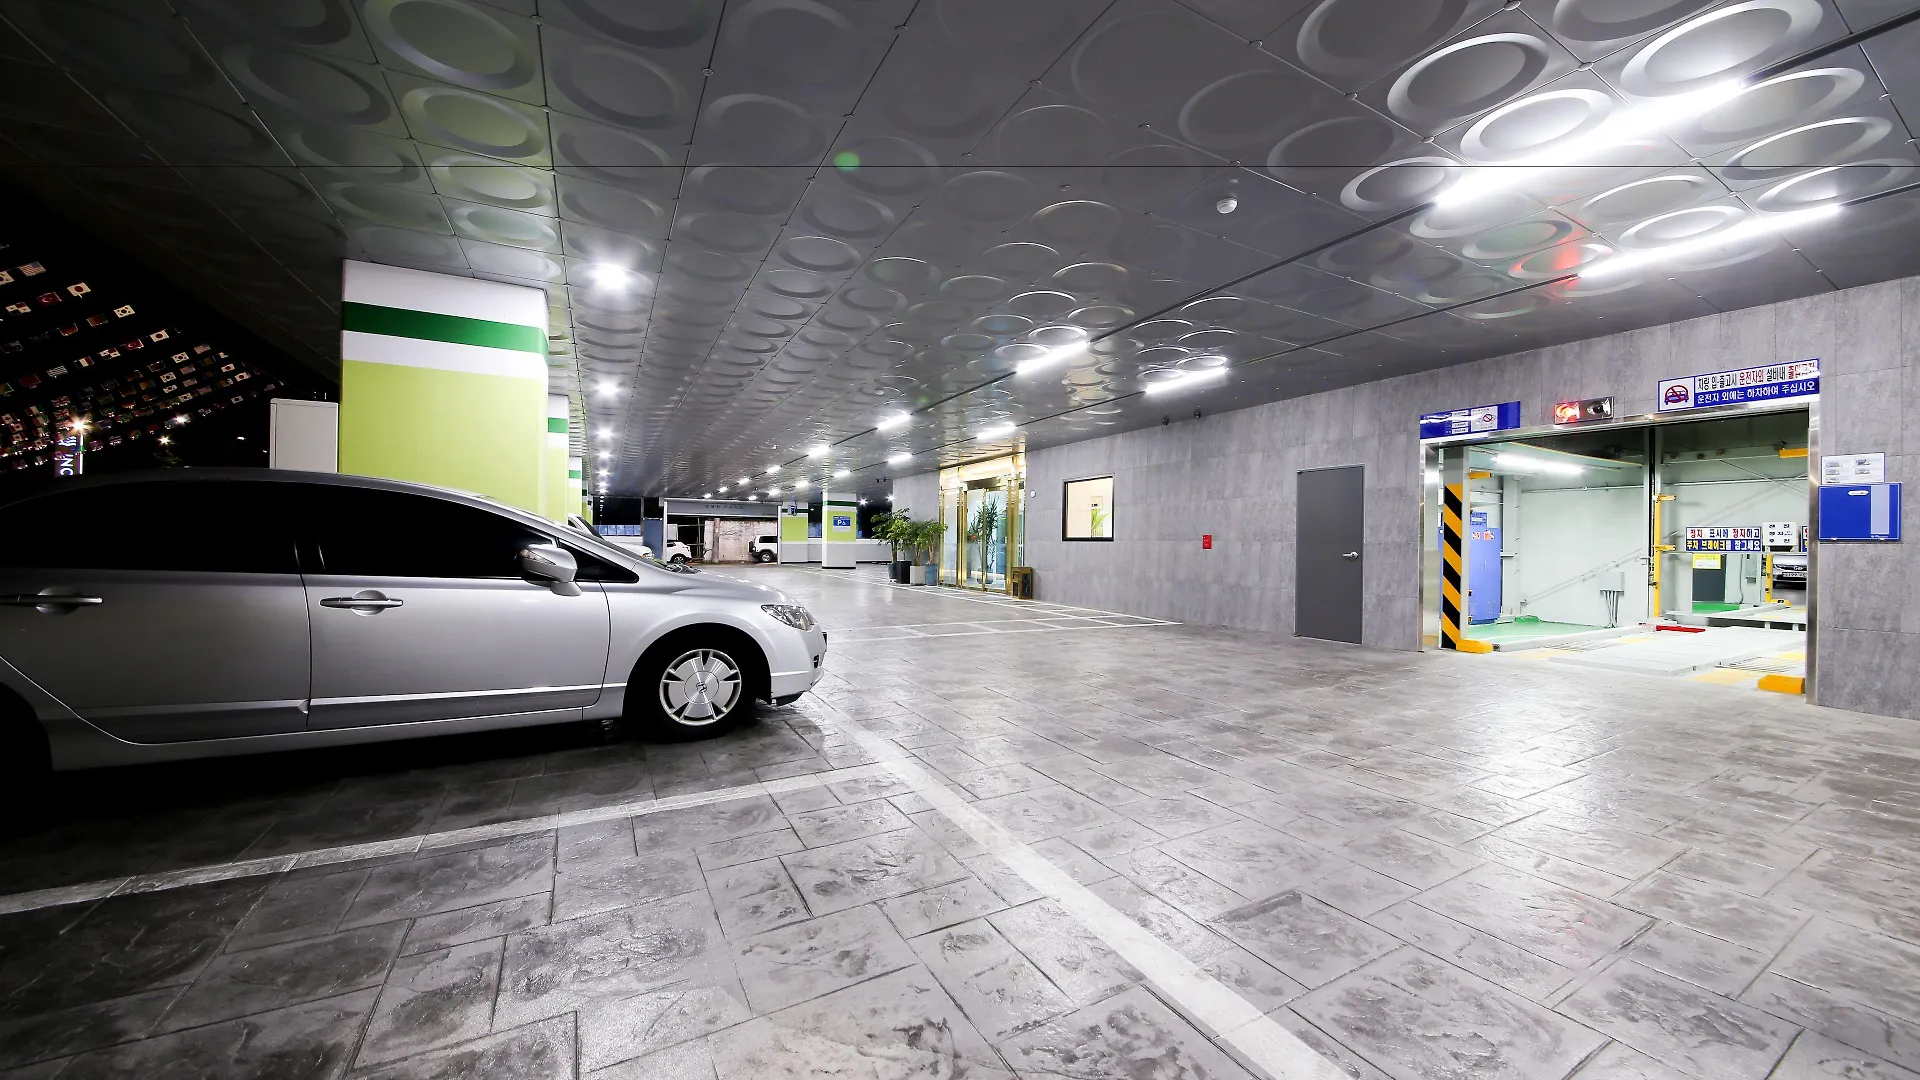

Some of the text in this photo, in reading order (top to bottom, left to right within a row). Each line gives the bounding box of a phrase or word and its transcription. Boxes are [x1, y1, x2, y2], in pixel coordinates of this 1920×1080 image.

[1698, 377, 1709, 390] 차량
[1766, 366, 1786, 382] 설비내
[1697, 381, 1815, 404] 운전자 외에는 하차하여 주십시오
[1690, 528, 1703, 539] 정지
[1732, 528, 1760, 539] 정지하고
[1686, 540, 1699, 550] 주차
